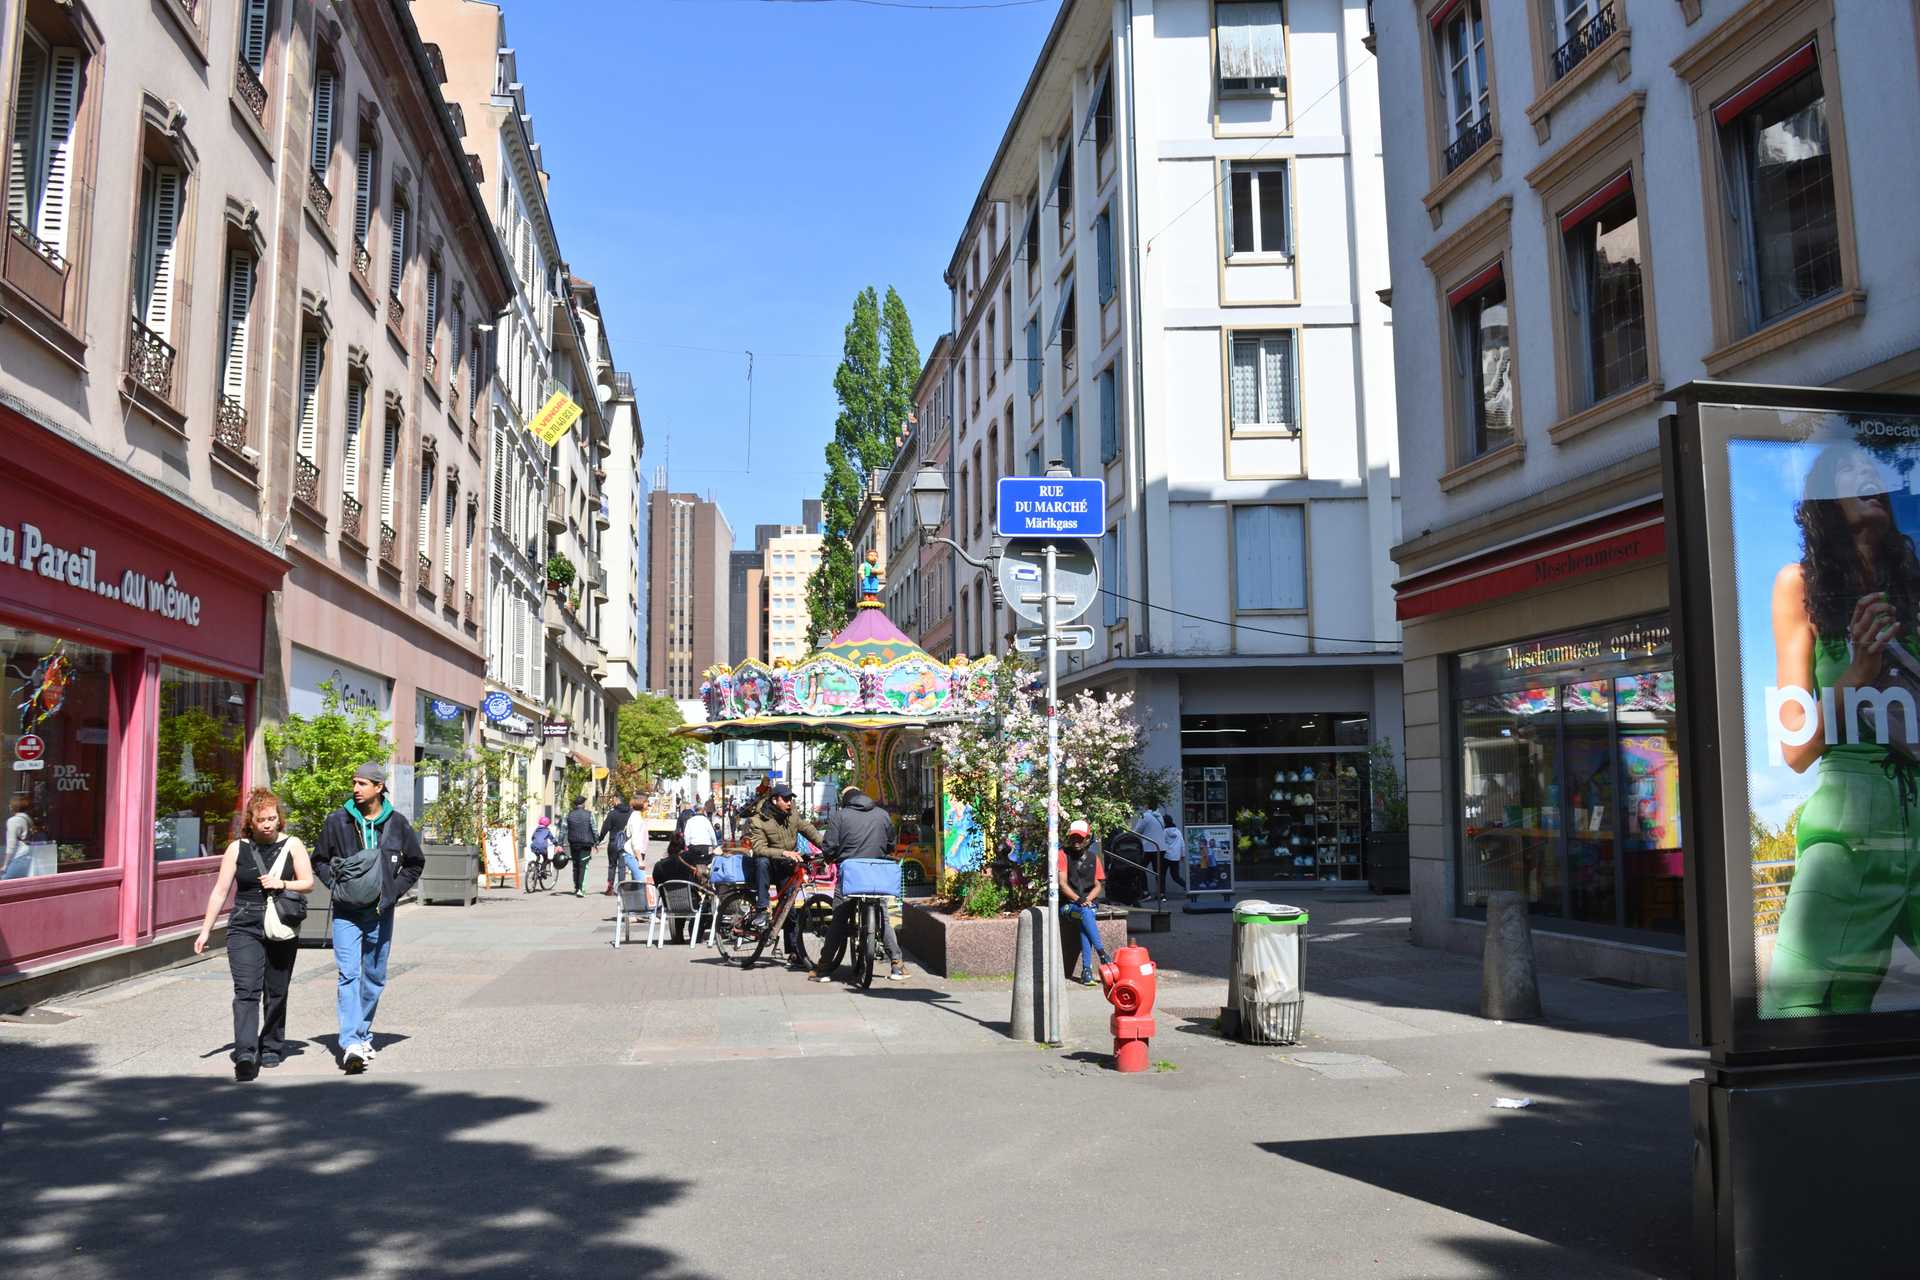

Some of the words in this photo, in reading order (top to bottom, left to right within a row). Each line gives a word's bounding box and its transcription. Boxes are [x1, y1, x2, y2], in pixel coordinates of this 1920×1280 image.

[1040, 485, 1064, 497] RUE
[1015, 501, 1032, 513] DU
[1034, 498, 1088, 513] MARCHÉ
[1025, 517, 1078, 531] Märikgass
[121, 569, 145, 610] au
[147, 570, 200, 627] même
[1505, 641, 1602, 671] Meschenmoser
[1610, 624, 1671, 660] optique
[57, 777, 90, 792] am
